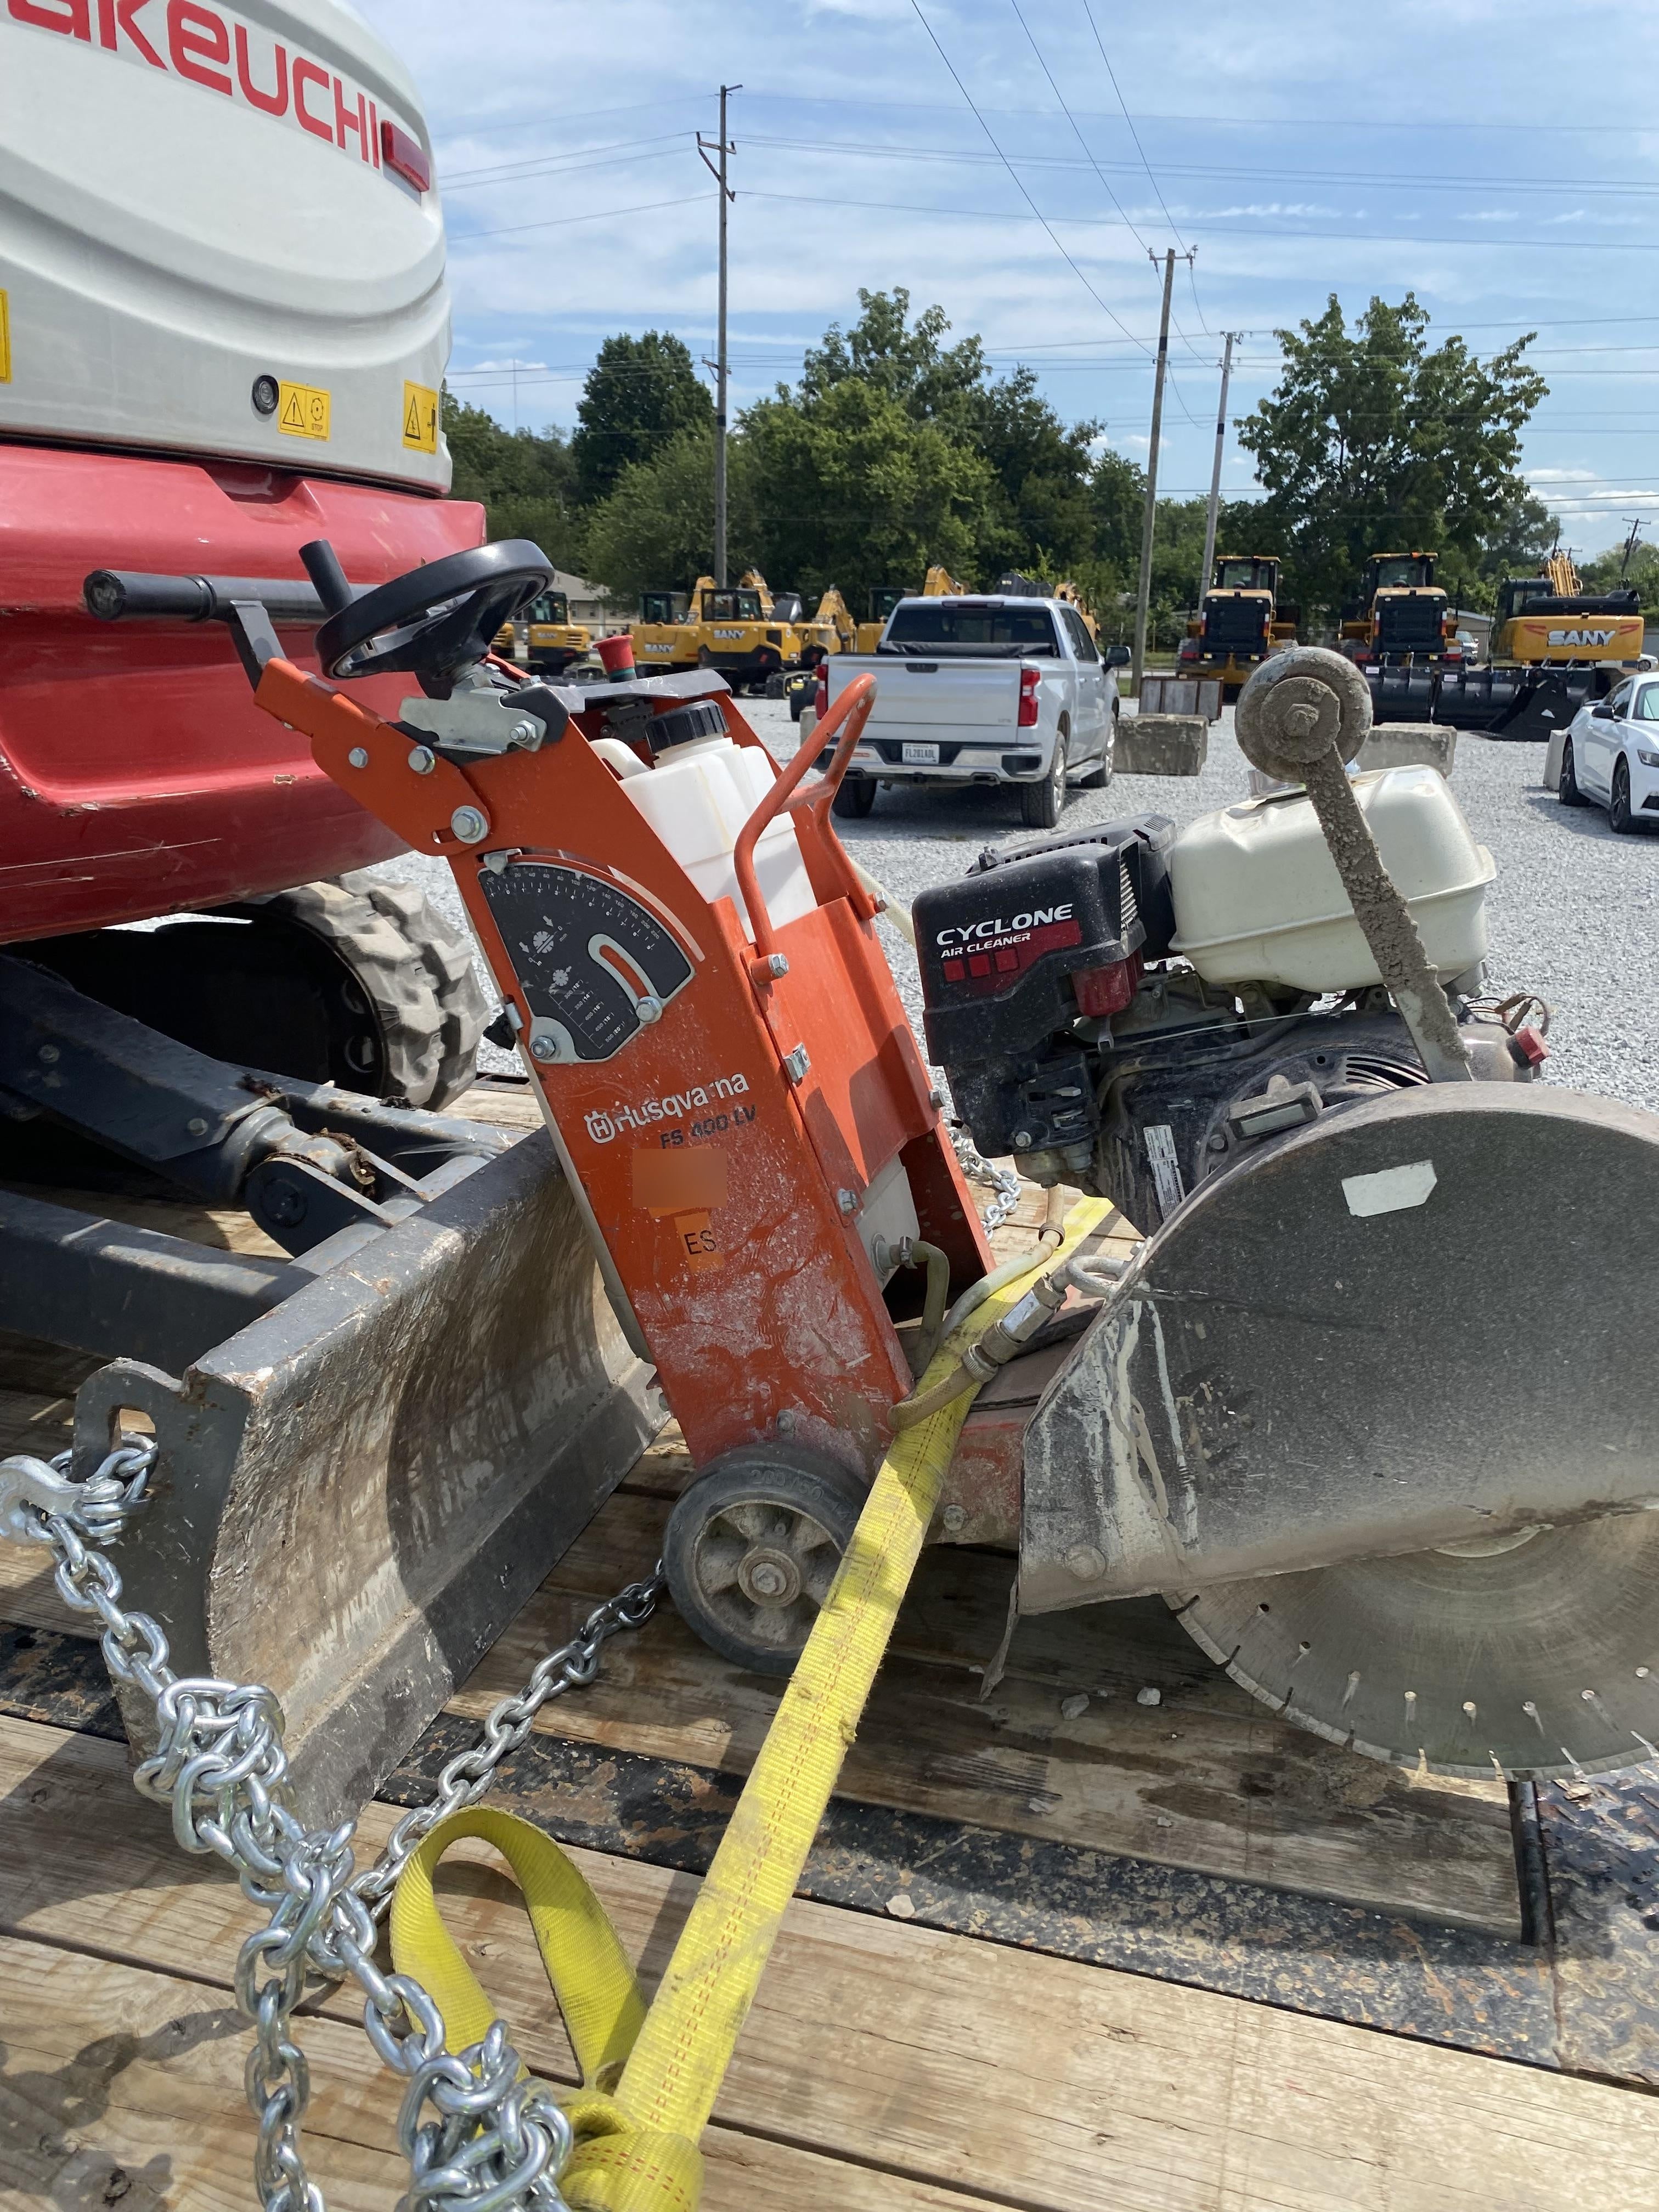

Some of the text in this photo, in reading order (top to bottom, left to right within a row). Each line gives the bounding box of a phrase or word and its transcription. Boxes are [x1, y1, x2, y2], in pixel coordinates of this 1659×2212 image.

[312, 423, 323, 432] STOP
[713, 629, 746, 639] SANY
[1548, 630, 1616, 647] SANY
[644, 643, 676, 654] SANY
[641, 920, 650, 929] 200
[936, 903, 1073, 946] CYCLONE
[940, 932, 1031, 958] AIR CLEANER
[614, 1073, 750, 1132] Husqvana
[660, 1128, 684, 1149] FS
[734, 1104, 757, 1126] LV
[684, 1229, 717, 1255] ES
